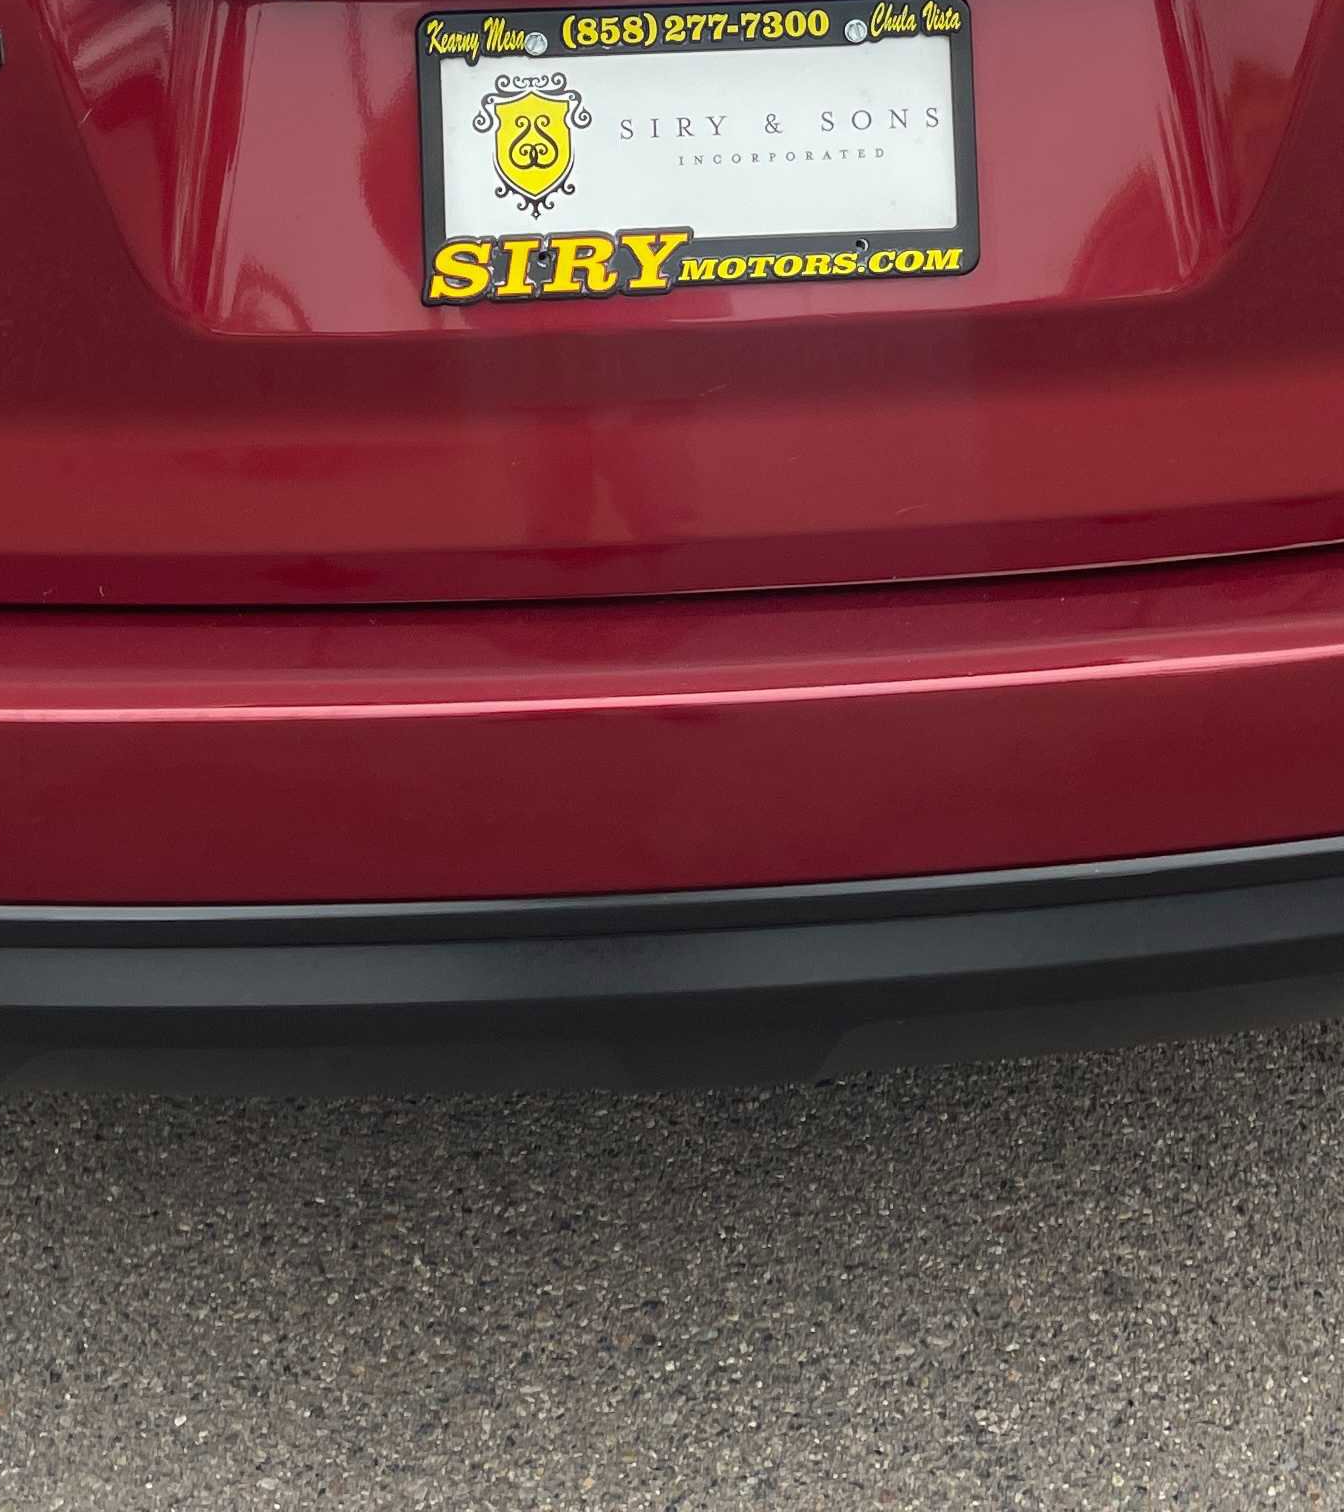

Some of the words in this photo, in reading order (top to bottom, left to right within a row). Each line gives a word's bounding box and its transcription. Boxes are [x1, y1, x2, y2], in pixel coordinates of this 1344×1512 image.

[562, 11, 657, 48] (858)
[664, 9, 830, 45] 277-7300
[870, 1, 918, 35] Chula
[922, 0, 961, 32] Vista
[427, 20, 481, 60] Kearny
[483, 16, 526, 52] Mesa
[620, 115, 728, 140] SIRY
[764, 113, 784, 135] &
[820, 106, 942, 133] SONS
[678, 147, 886, 165] INCORPORATED
[429, 232, 688, 300] SIRY
[678, 248, 961, 282] MOTORS.COM
